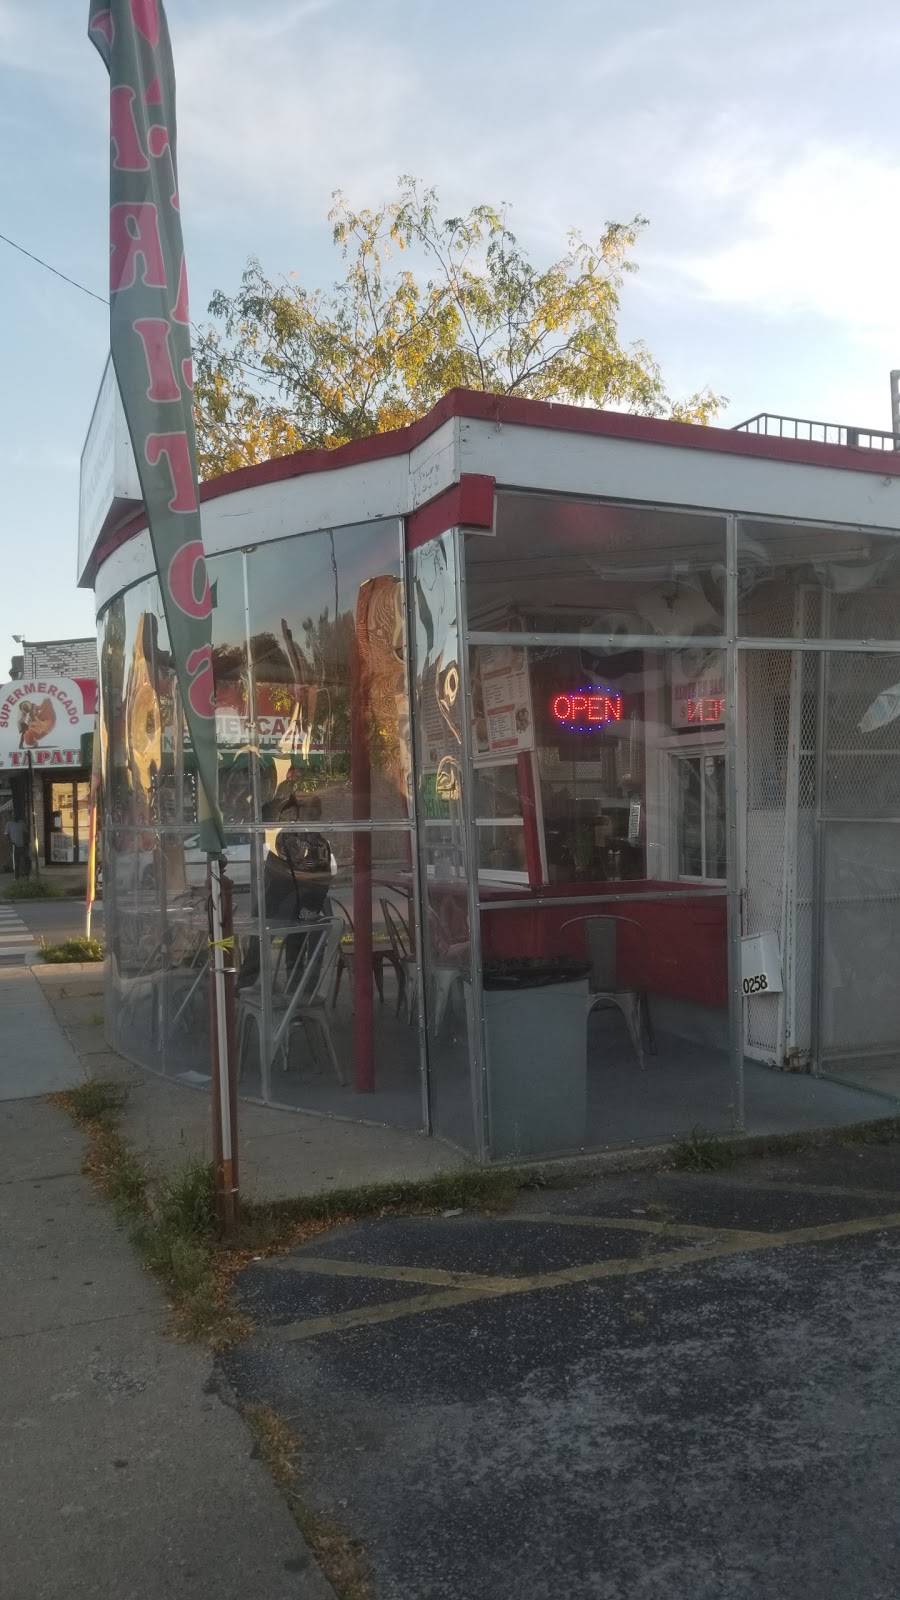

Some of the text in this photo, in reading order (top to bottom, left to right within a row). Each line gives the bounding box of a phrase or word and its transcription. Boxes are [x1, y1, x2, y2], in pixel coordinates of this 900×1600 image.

[0, 682, 80, 729] SUPERMERCADO
[553, 694, 623, 721] OPEN
[743, 974, 768, 994] 0258
